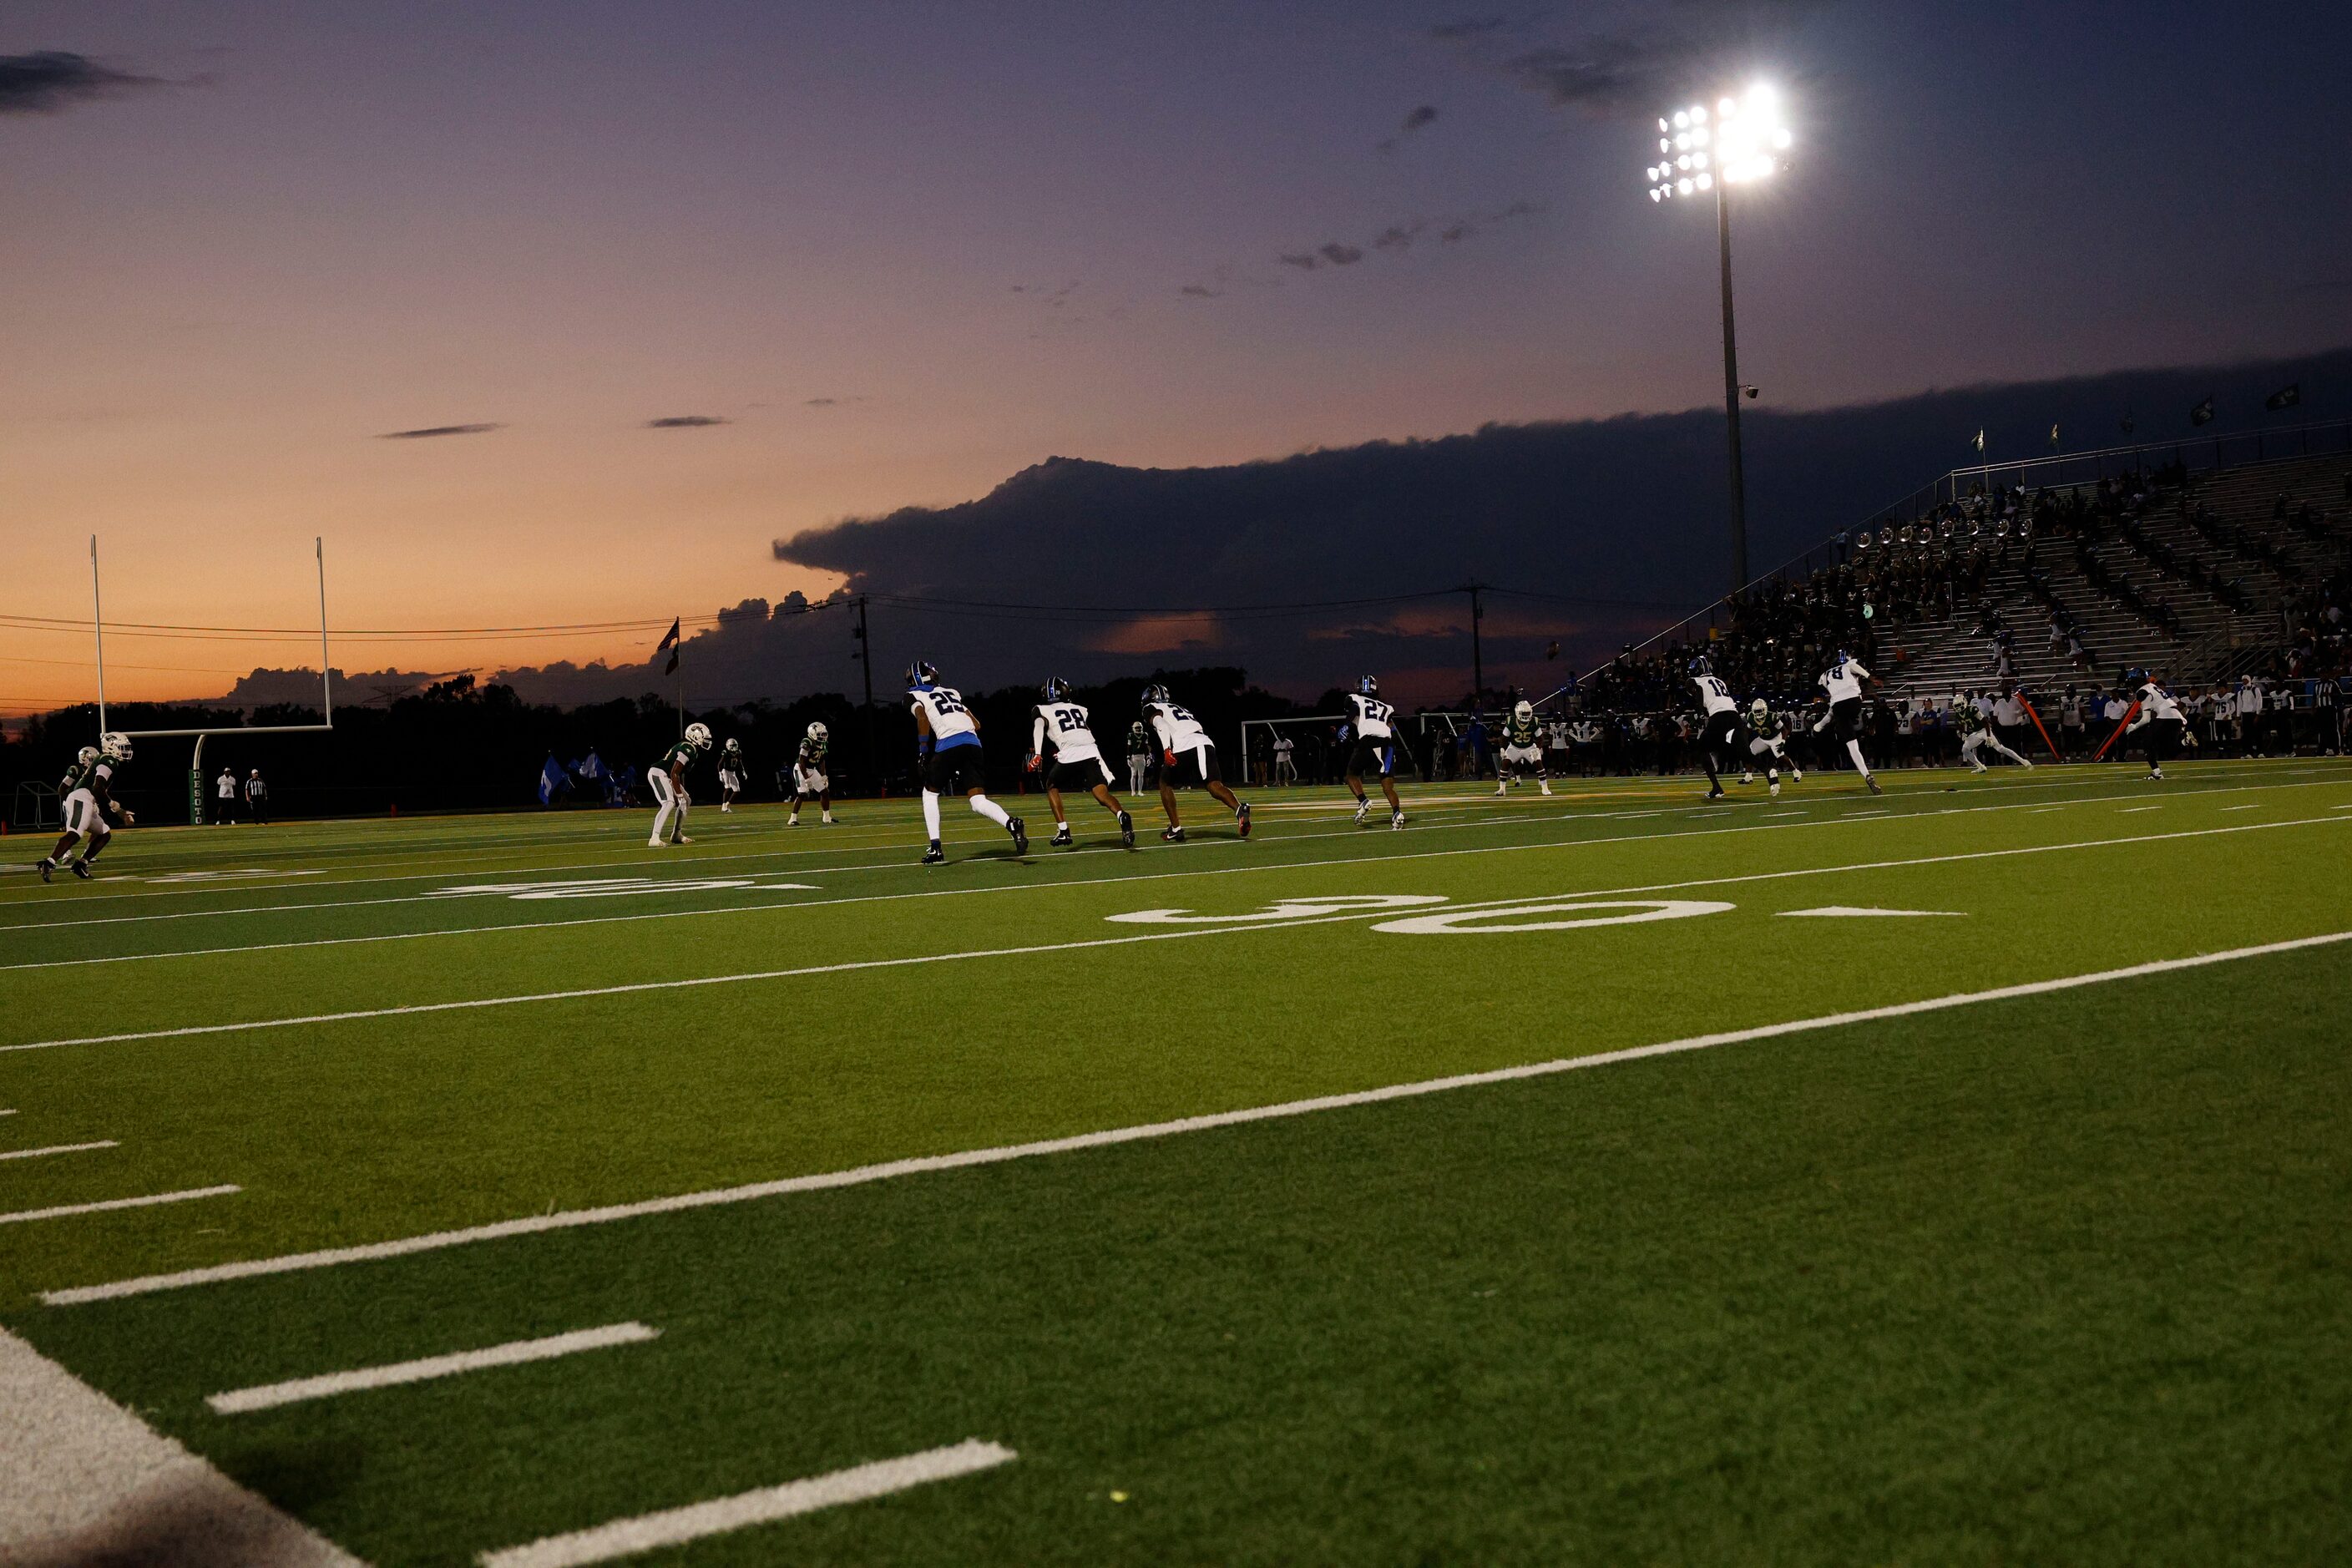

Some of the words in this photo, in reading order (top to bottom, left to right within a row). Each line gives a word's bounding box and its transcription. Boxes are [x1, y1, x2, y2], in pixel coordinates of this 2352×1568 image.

[1707, 679, 1730, 696] 18
[929, 690, 965, 715] 25
[1364, 699, 1387, 723] 27
[1055, 708, 1087, 732] 28
[1514, 731, 1532, 743] 25
[193, 771, 203, 825] DESOTO
